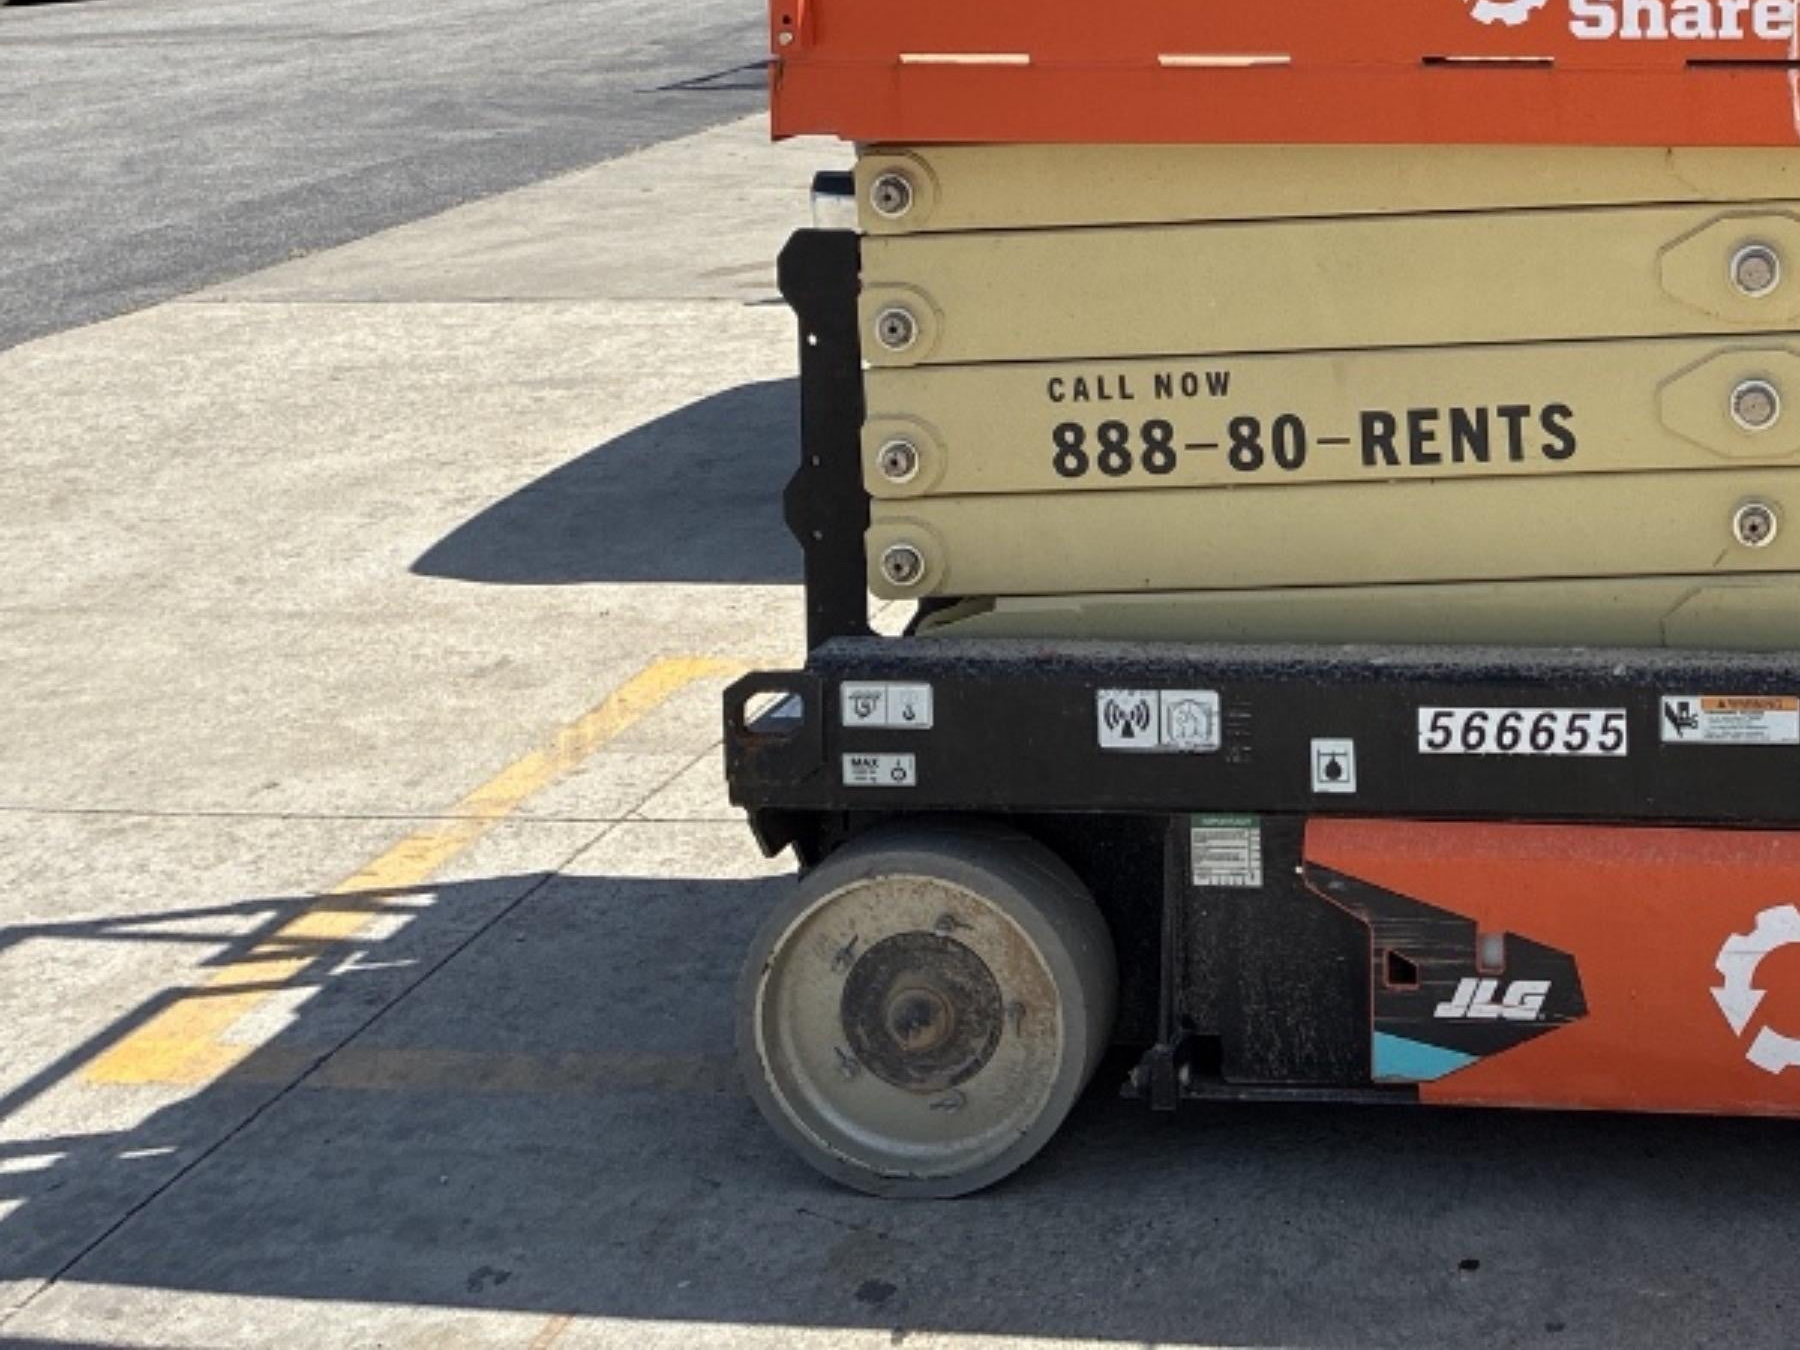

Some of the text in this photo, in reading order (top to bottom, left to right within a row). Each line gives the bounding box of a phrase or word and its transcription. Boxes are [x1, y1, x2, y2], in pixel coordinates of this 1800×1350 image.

[1047, 371, 1231, 402] CALL NOW
[1051, 403, 1578, 478] 888-80-RENTS
[1426, 710, 1625, 752] 566655
[1433, 977, 1552, 1020] JLG
